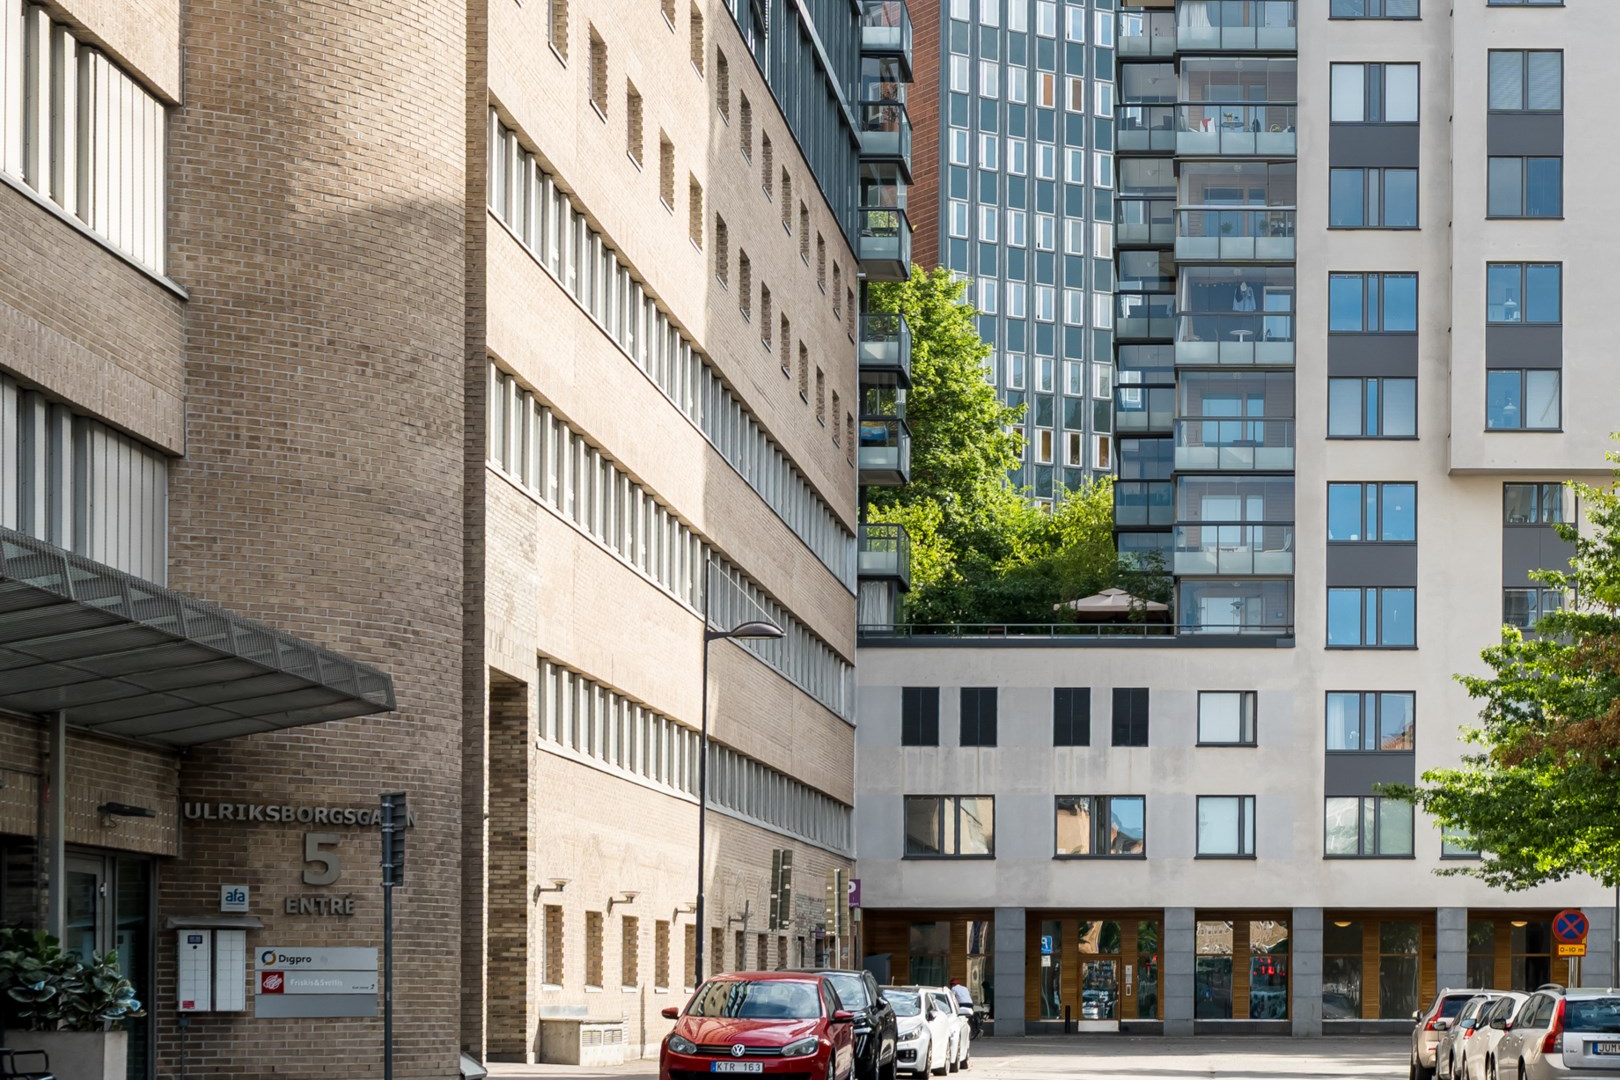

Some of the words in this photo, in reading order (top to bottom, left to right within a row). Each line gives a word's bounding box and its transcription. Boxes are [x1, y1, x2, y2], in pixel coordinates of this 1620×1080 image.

[185, 802, 417, 827] ULRIKSBORGSGAN
[303, 832, 342, 886] 5
[225, 888, 246, 902] afa
[285, 893, 356, 915] ENTRÉ
[278, 954, 312, 965] Digpro
[1599, 1042, 1617, 1052] JUM
[717, 1063, 735, 1071] KTR
[744, 1063, 761, 1071] 163
